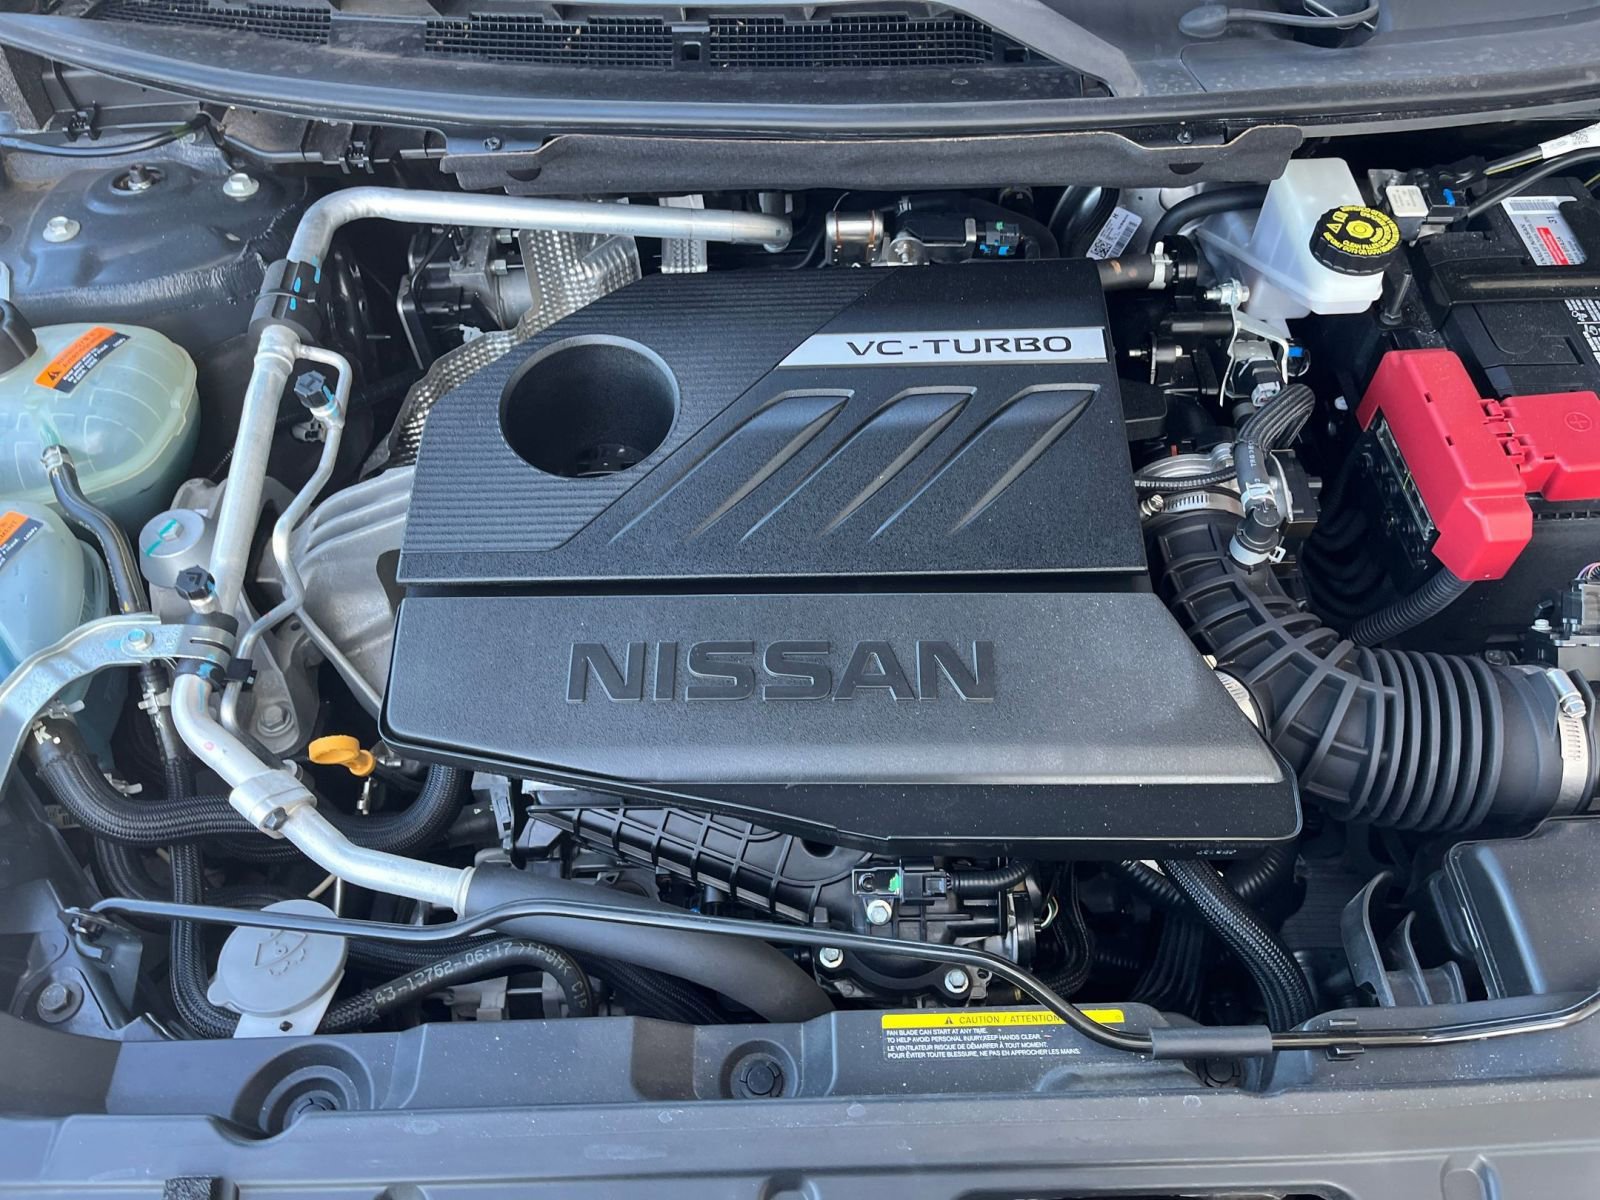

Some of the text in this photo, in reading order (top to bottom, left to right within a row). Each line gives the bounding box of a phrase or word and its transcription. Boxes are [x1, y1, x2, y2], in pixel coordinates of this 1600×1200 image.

[847, 335, 1072, 356] VC-TURBO
[566, 639, 995, 701] NISSAN
[959, 1015, 1000, 1025] CAUTION
[1010, 1014, 1061, 1023] ATTENTION
